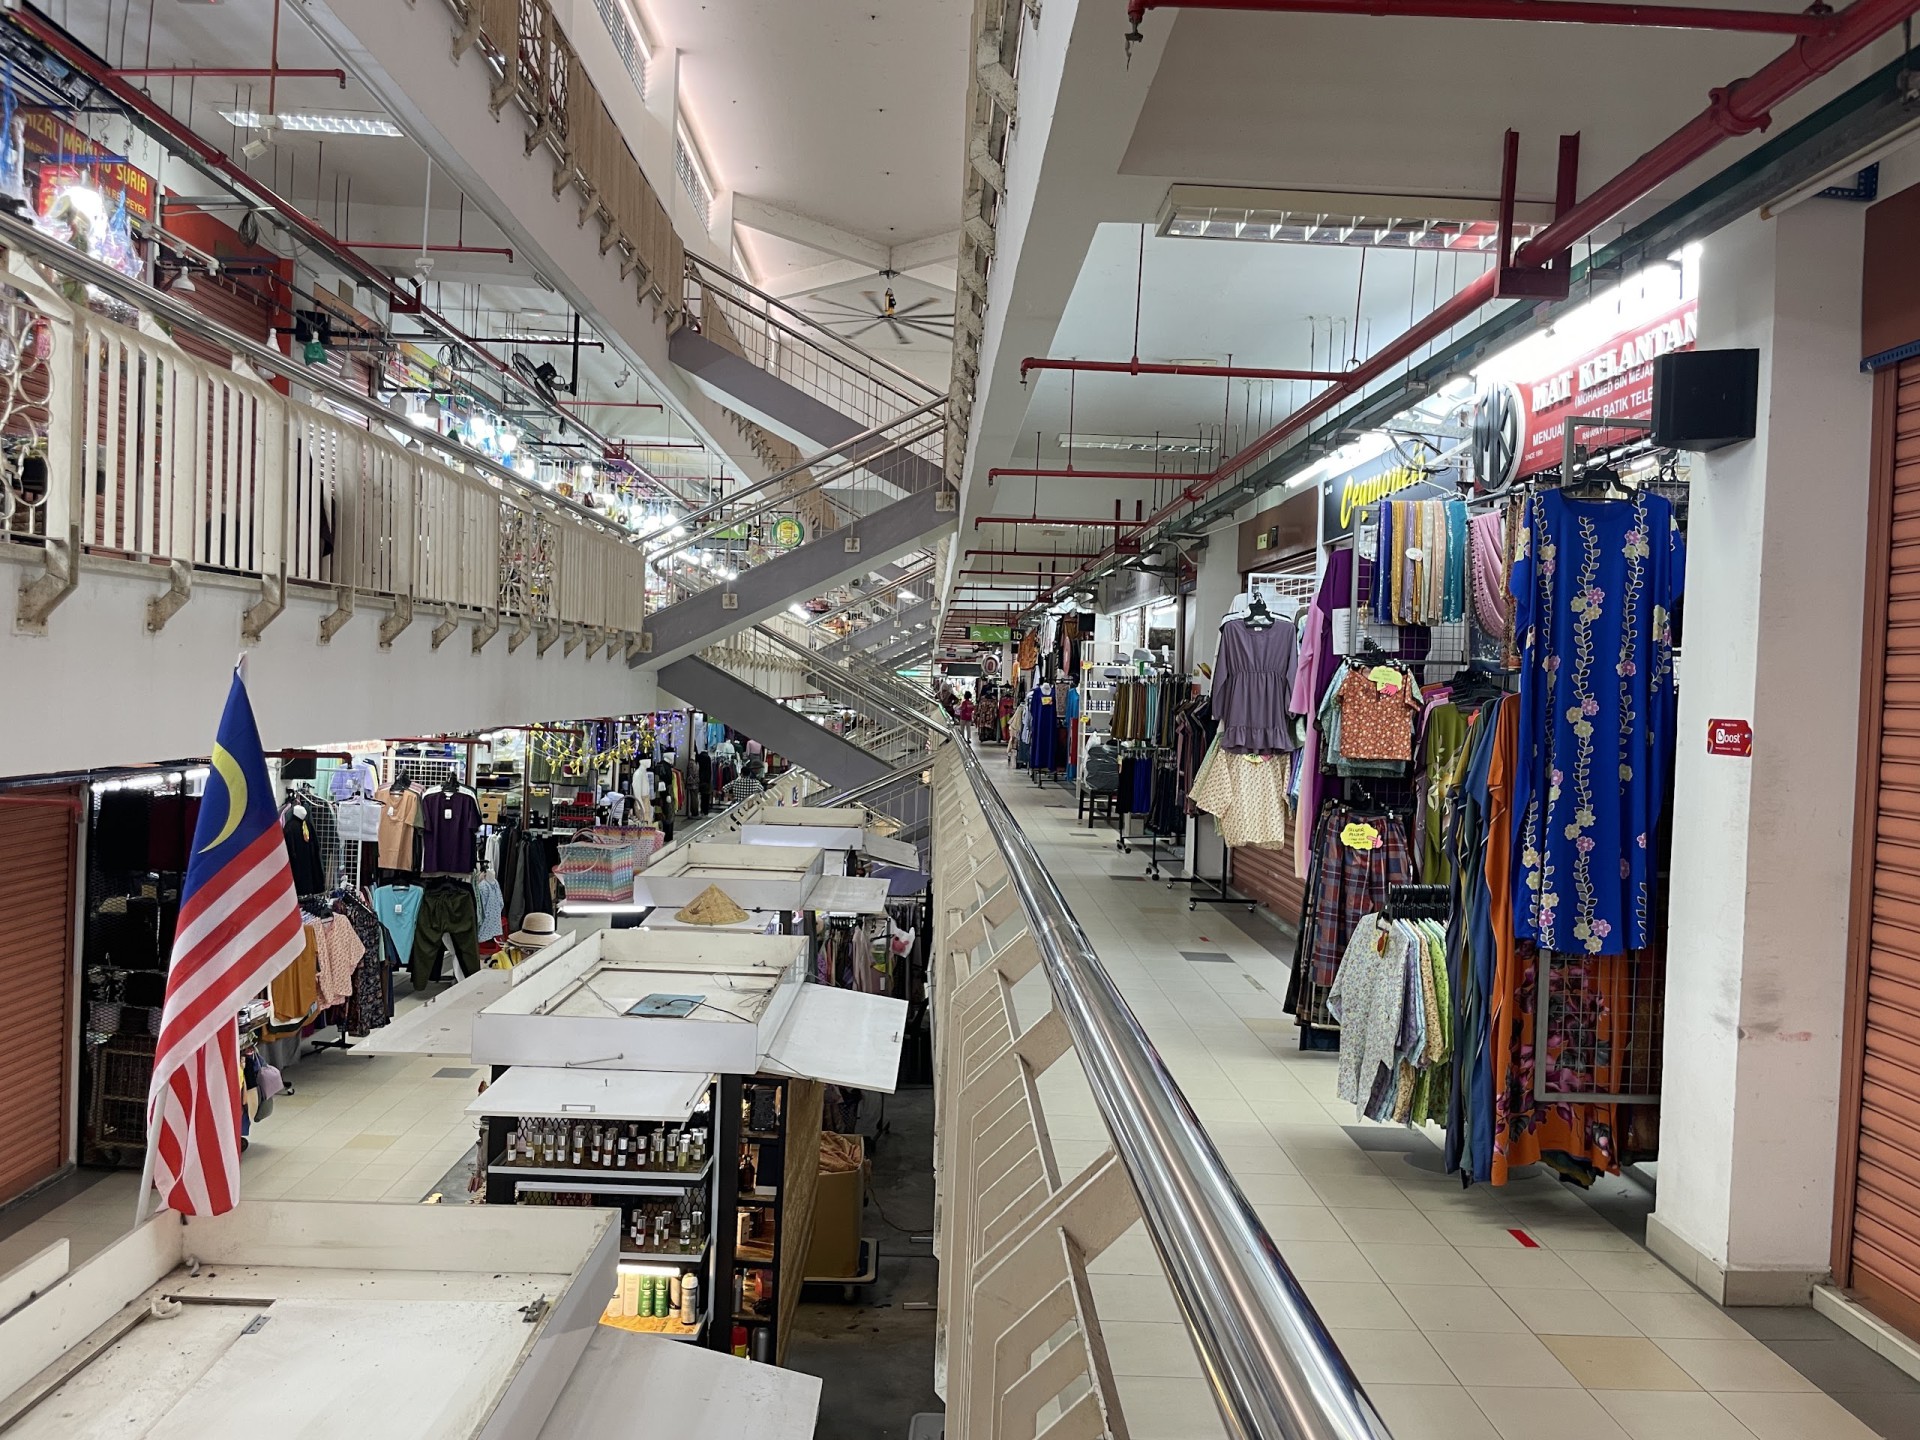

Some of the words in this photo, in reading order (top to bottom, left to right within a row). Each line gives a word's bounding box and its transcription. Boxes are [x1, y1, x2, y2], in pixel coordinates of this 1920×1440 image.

[116, 163, 148, 196] SURIA
[1531, 370, 1574, 412] MAT
[1577, 309, 1697, 391] KELANTAN
[1574, 382, 1614, 409] (MOHAMED
[1614, 376, 1628, 390] BIN
[1603, 395, 1629, 417] BATIK
[1630, 387, 1653, 408] TELE
[1012, 631, 1023, 640] 1b
